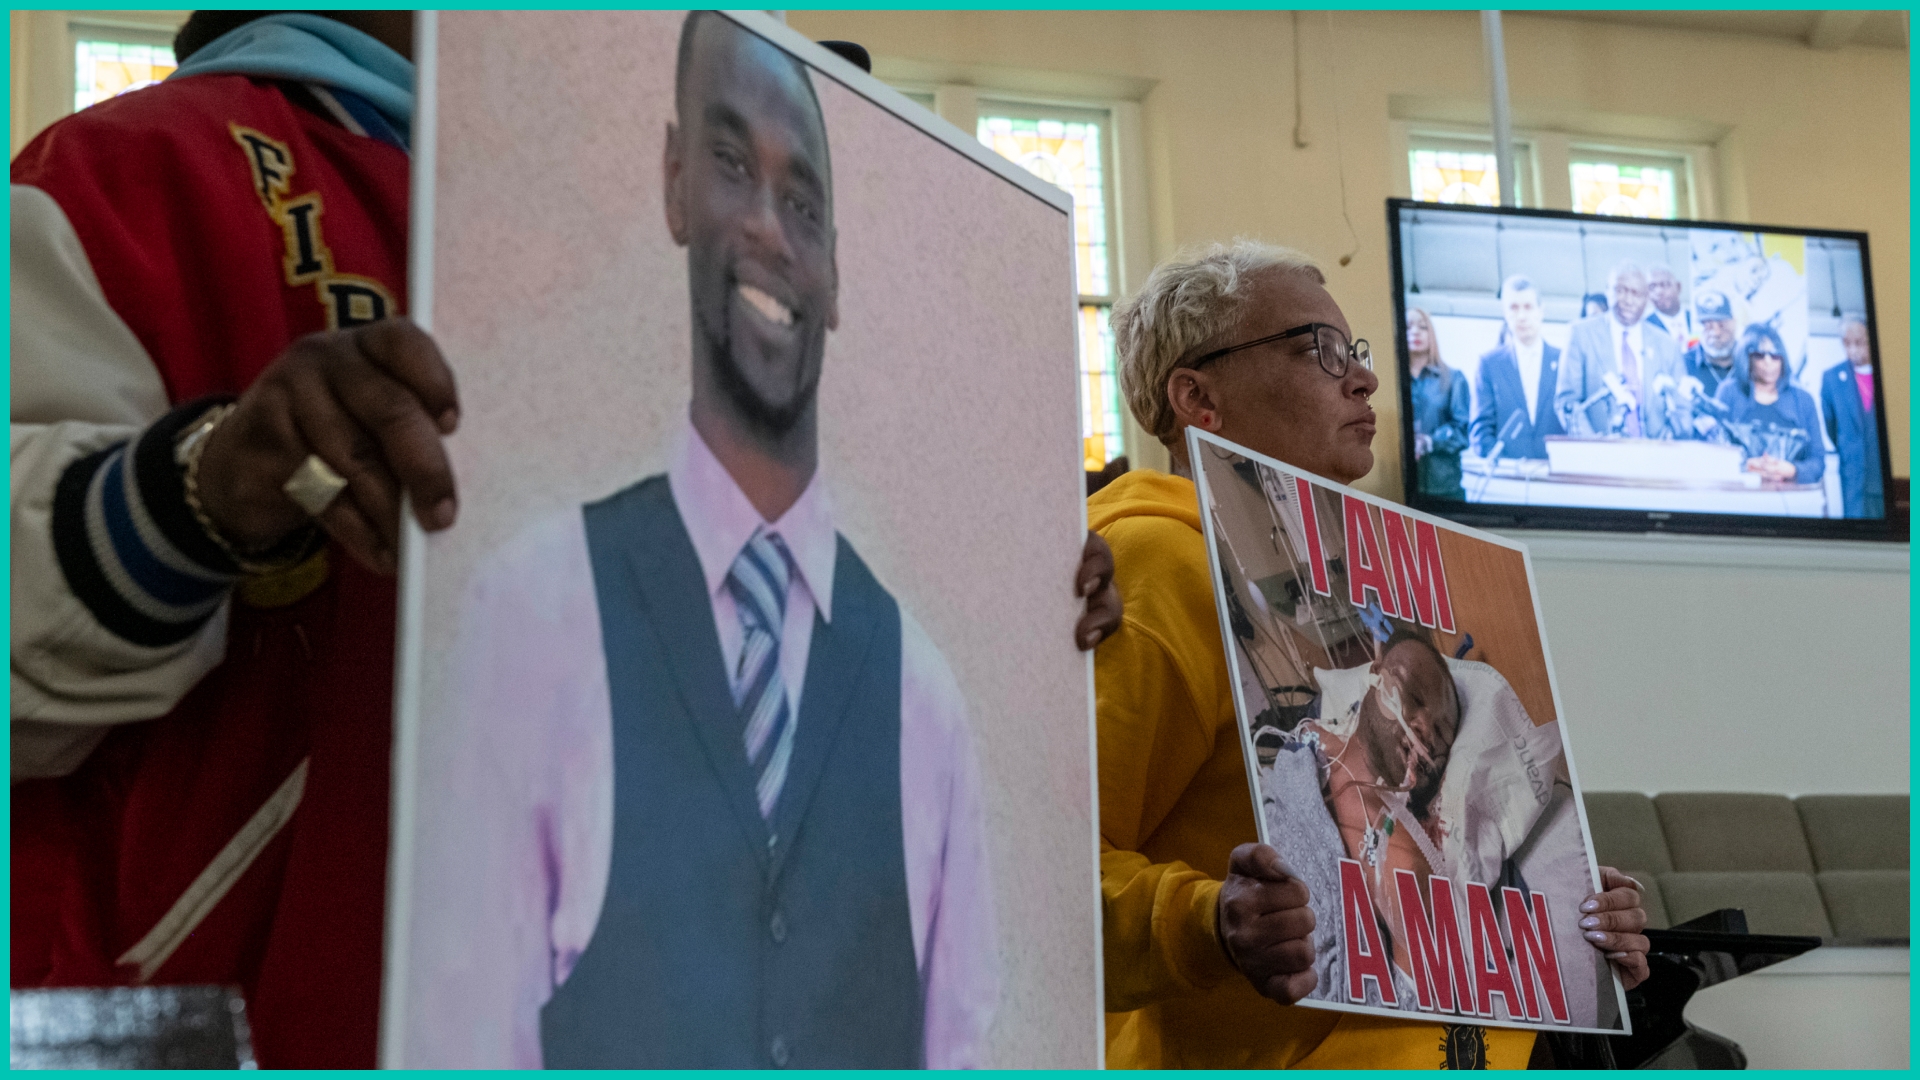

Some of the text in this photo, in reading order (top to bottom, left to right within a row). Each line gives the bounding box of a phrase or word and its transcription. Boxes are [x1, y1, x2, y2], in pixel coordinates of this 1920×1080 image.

[1295, 476, 1456, 634] I AM
[1338, 857, 1571, 1024] A MAN
